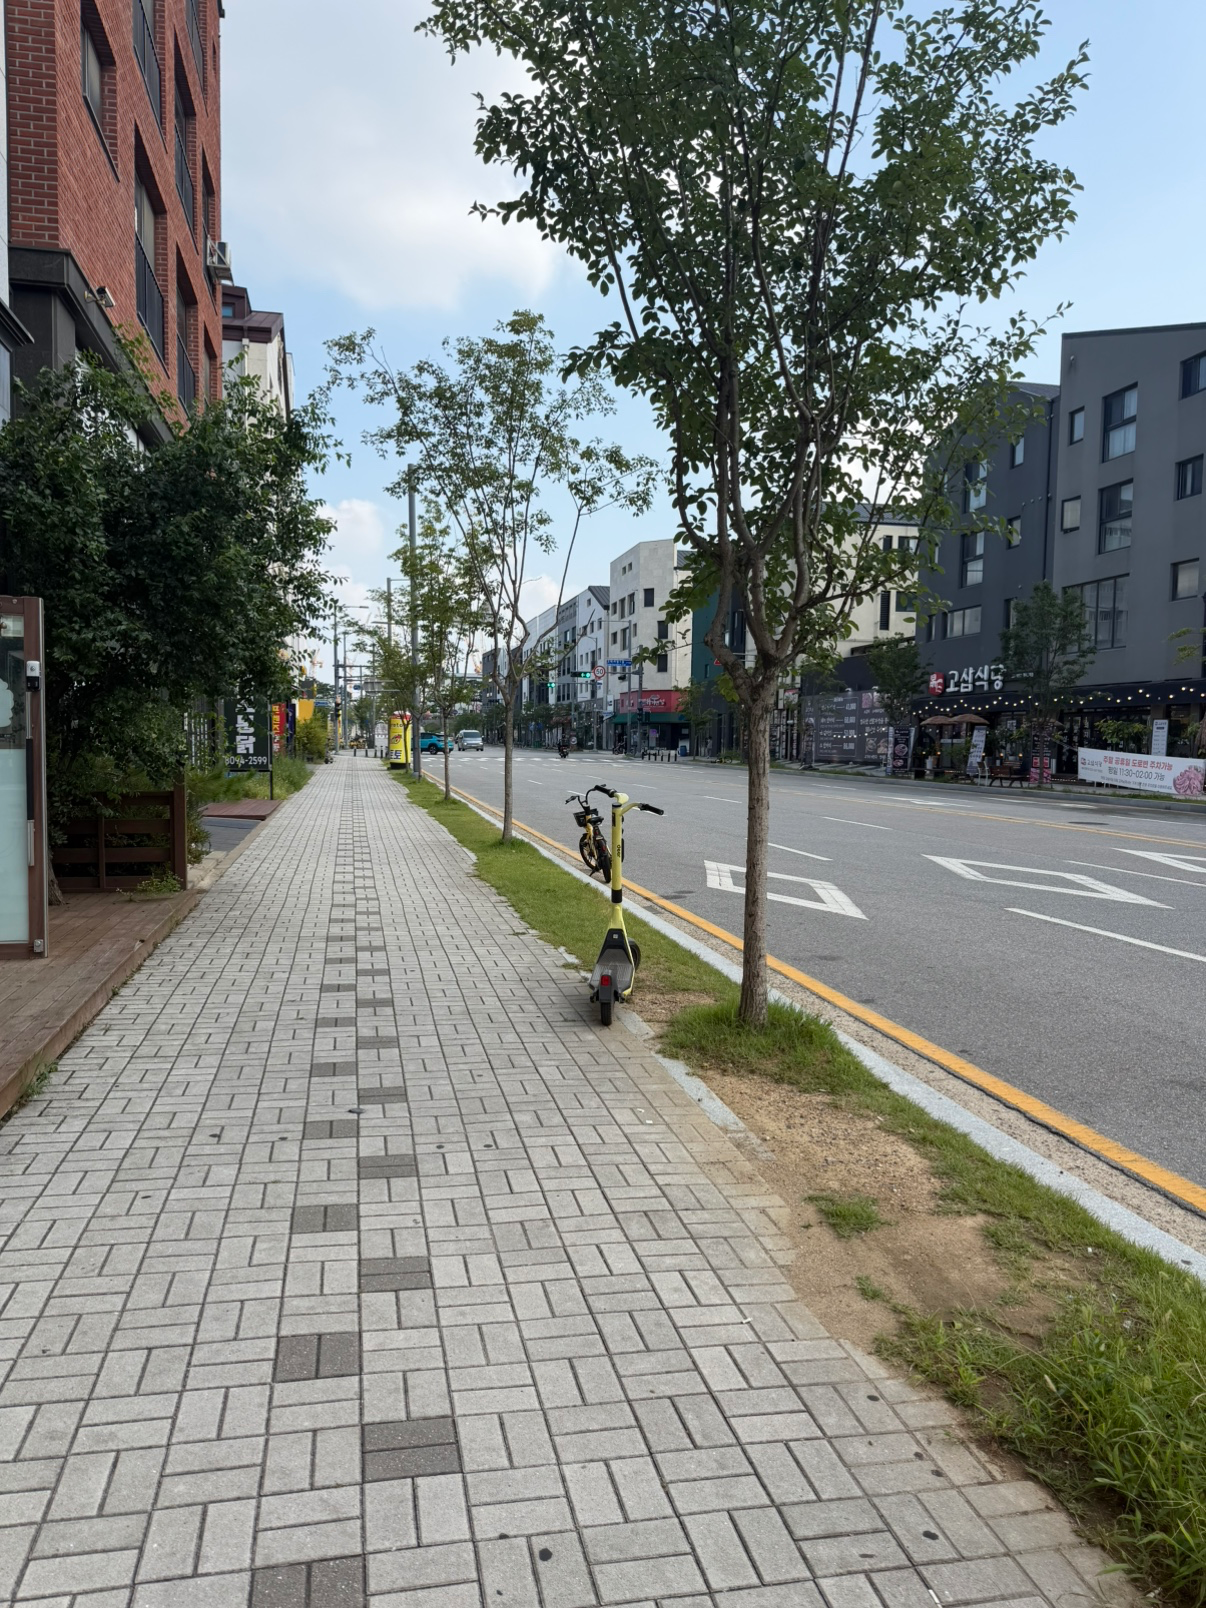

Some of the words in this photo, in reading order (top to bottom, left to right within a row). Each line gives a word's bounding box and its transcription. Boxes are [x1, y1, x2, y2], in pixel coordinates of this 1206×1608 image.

[945, 664, 1006, 693] 고삼식당
[1149, 760, 1173, 771] 주차가능
[1108, 766, 1118, 776] 평일
[1153, 772, 1165, 782] 가능
